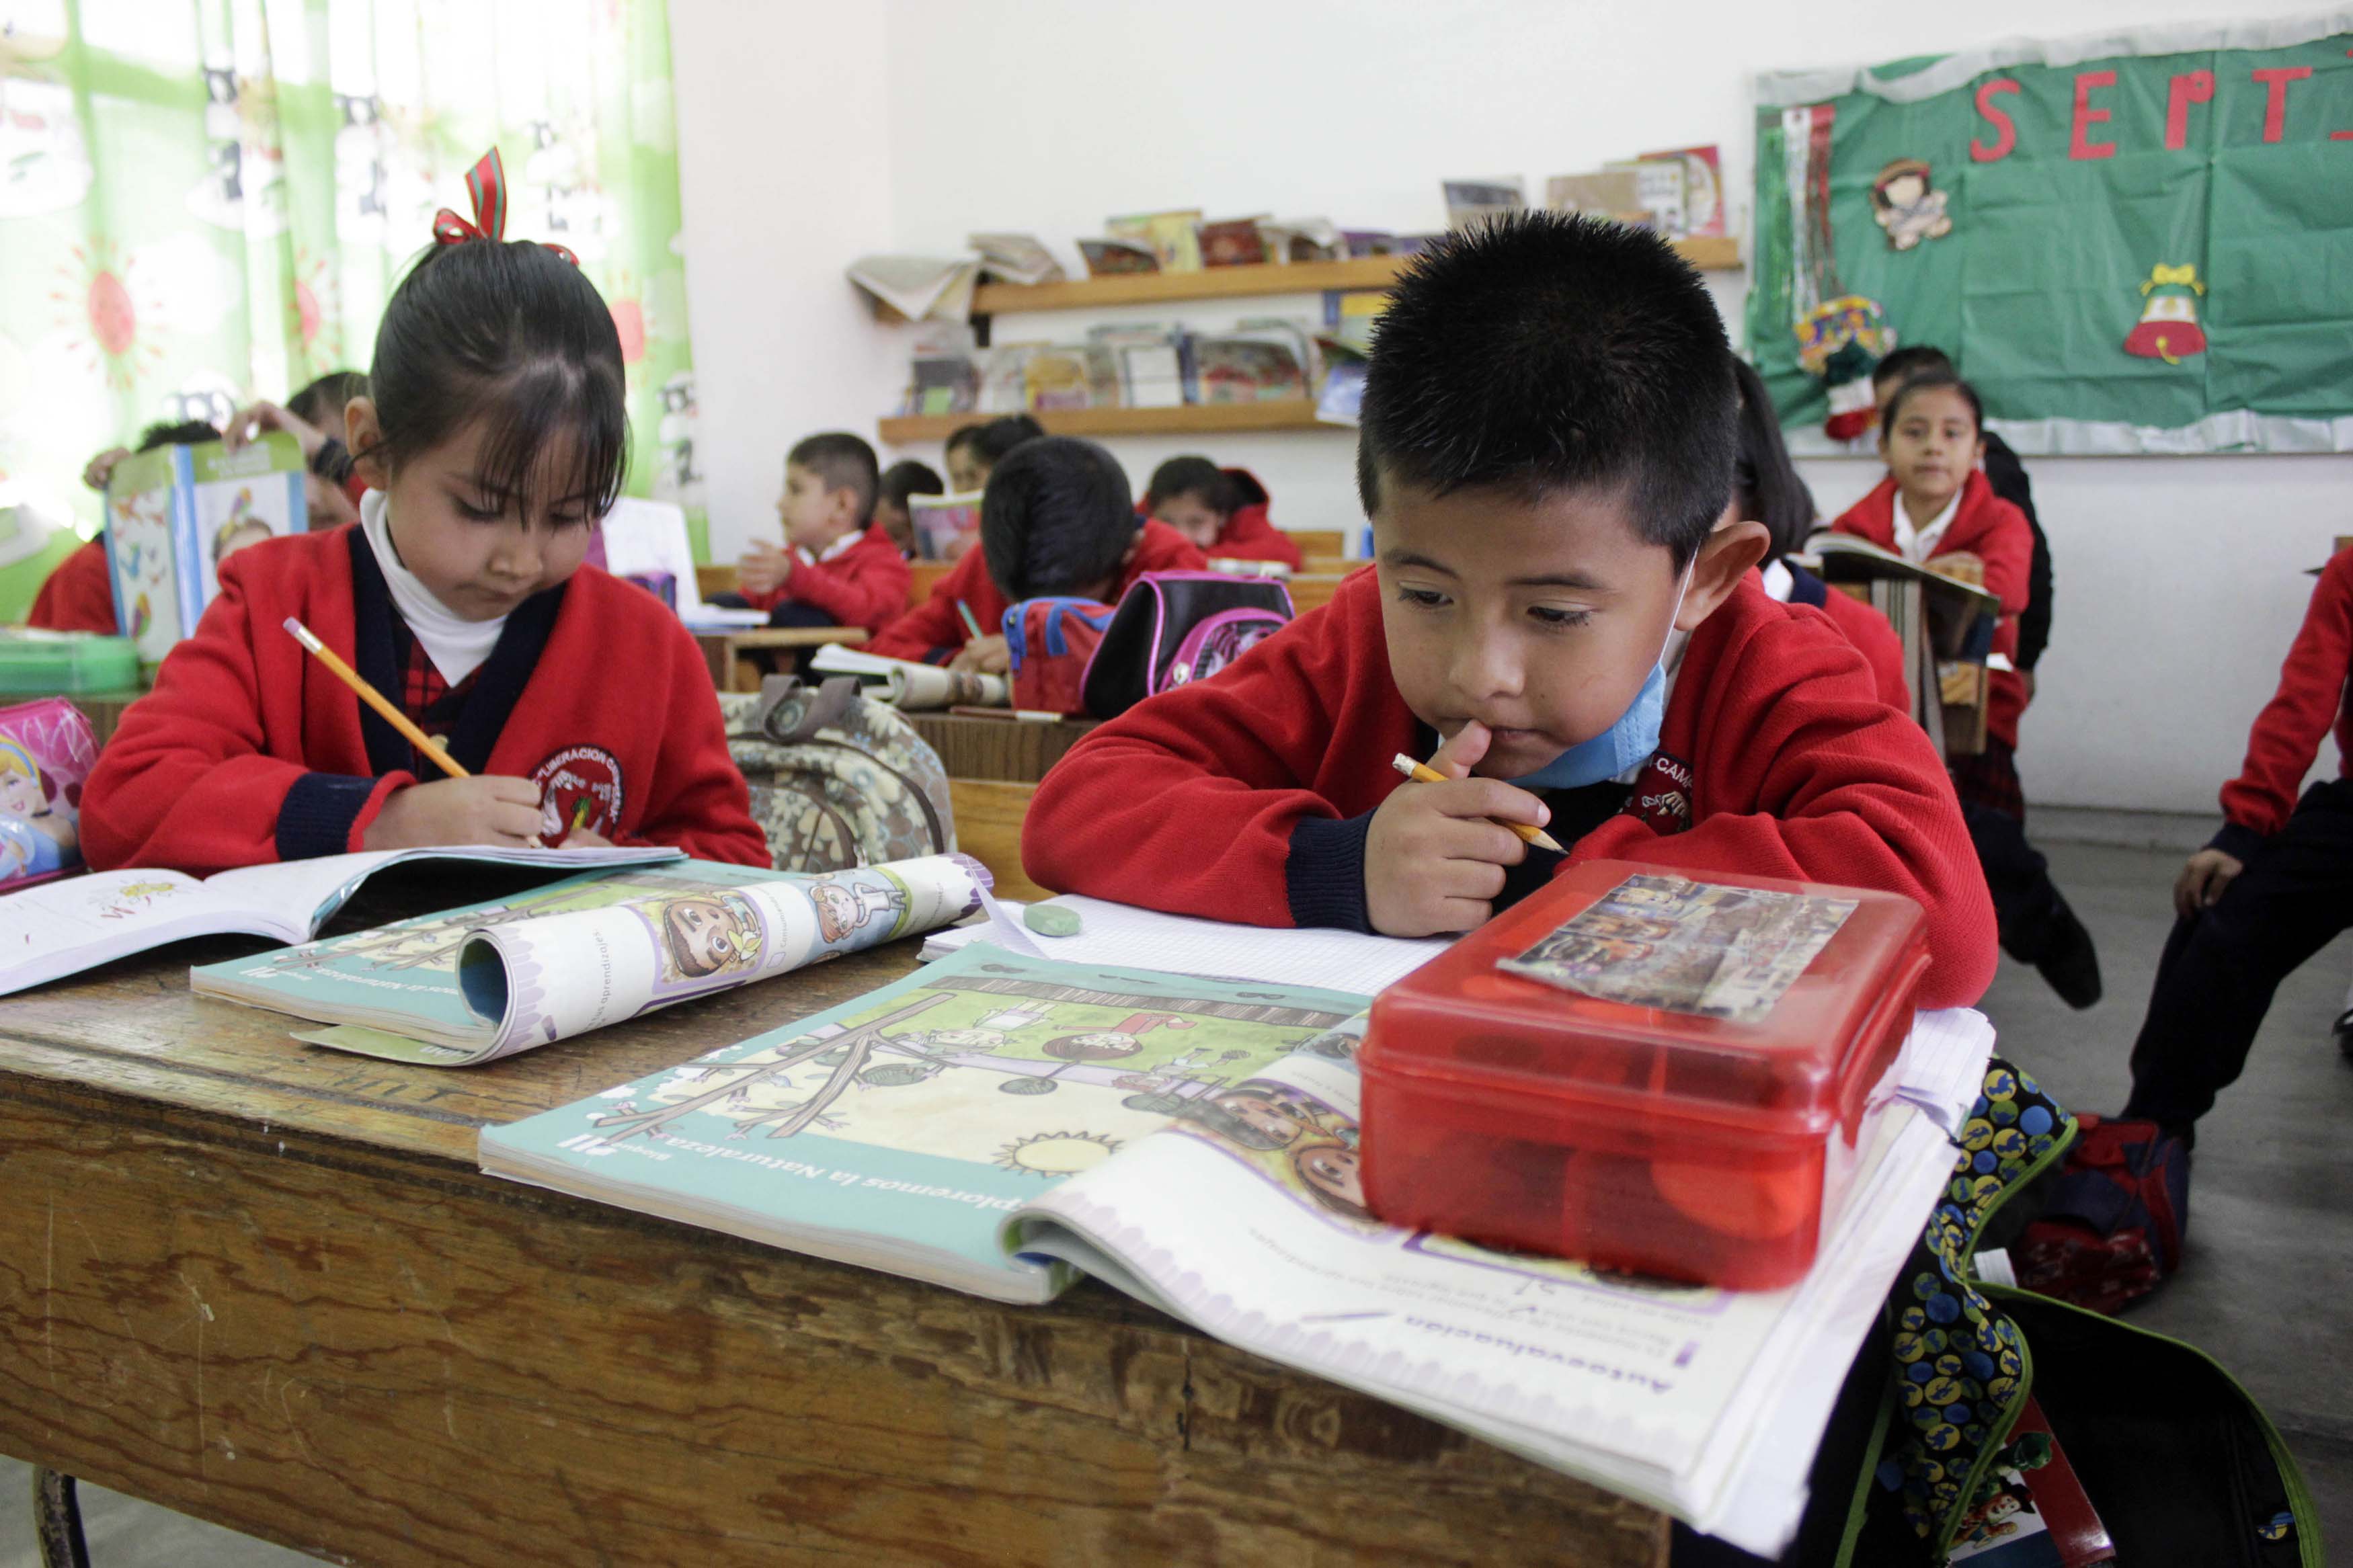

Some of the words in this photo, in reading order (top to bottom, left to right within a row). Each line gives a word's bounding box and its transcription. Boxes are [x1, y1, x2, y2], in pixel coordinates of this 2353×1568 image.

[666, 1137, 826, 1179] Naturaleza
[828, 1170, 861, 1186] la
[861, 1177, 1023, 1210] ploremos
